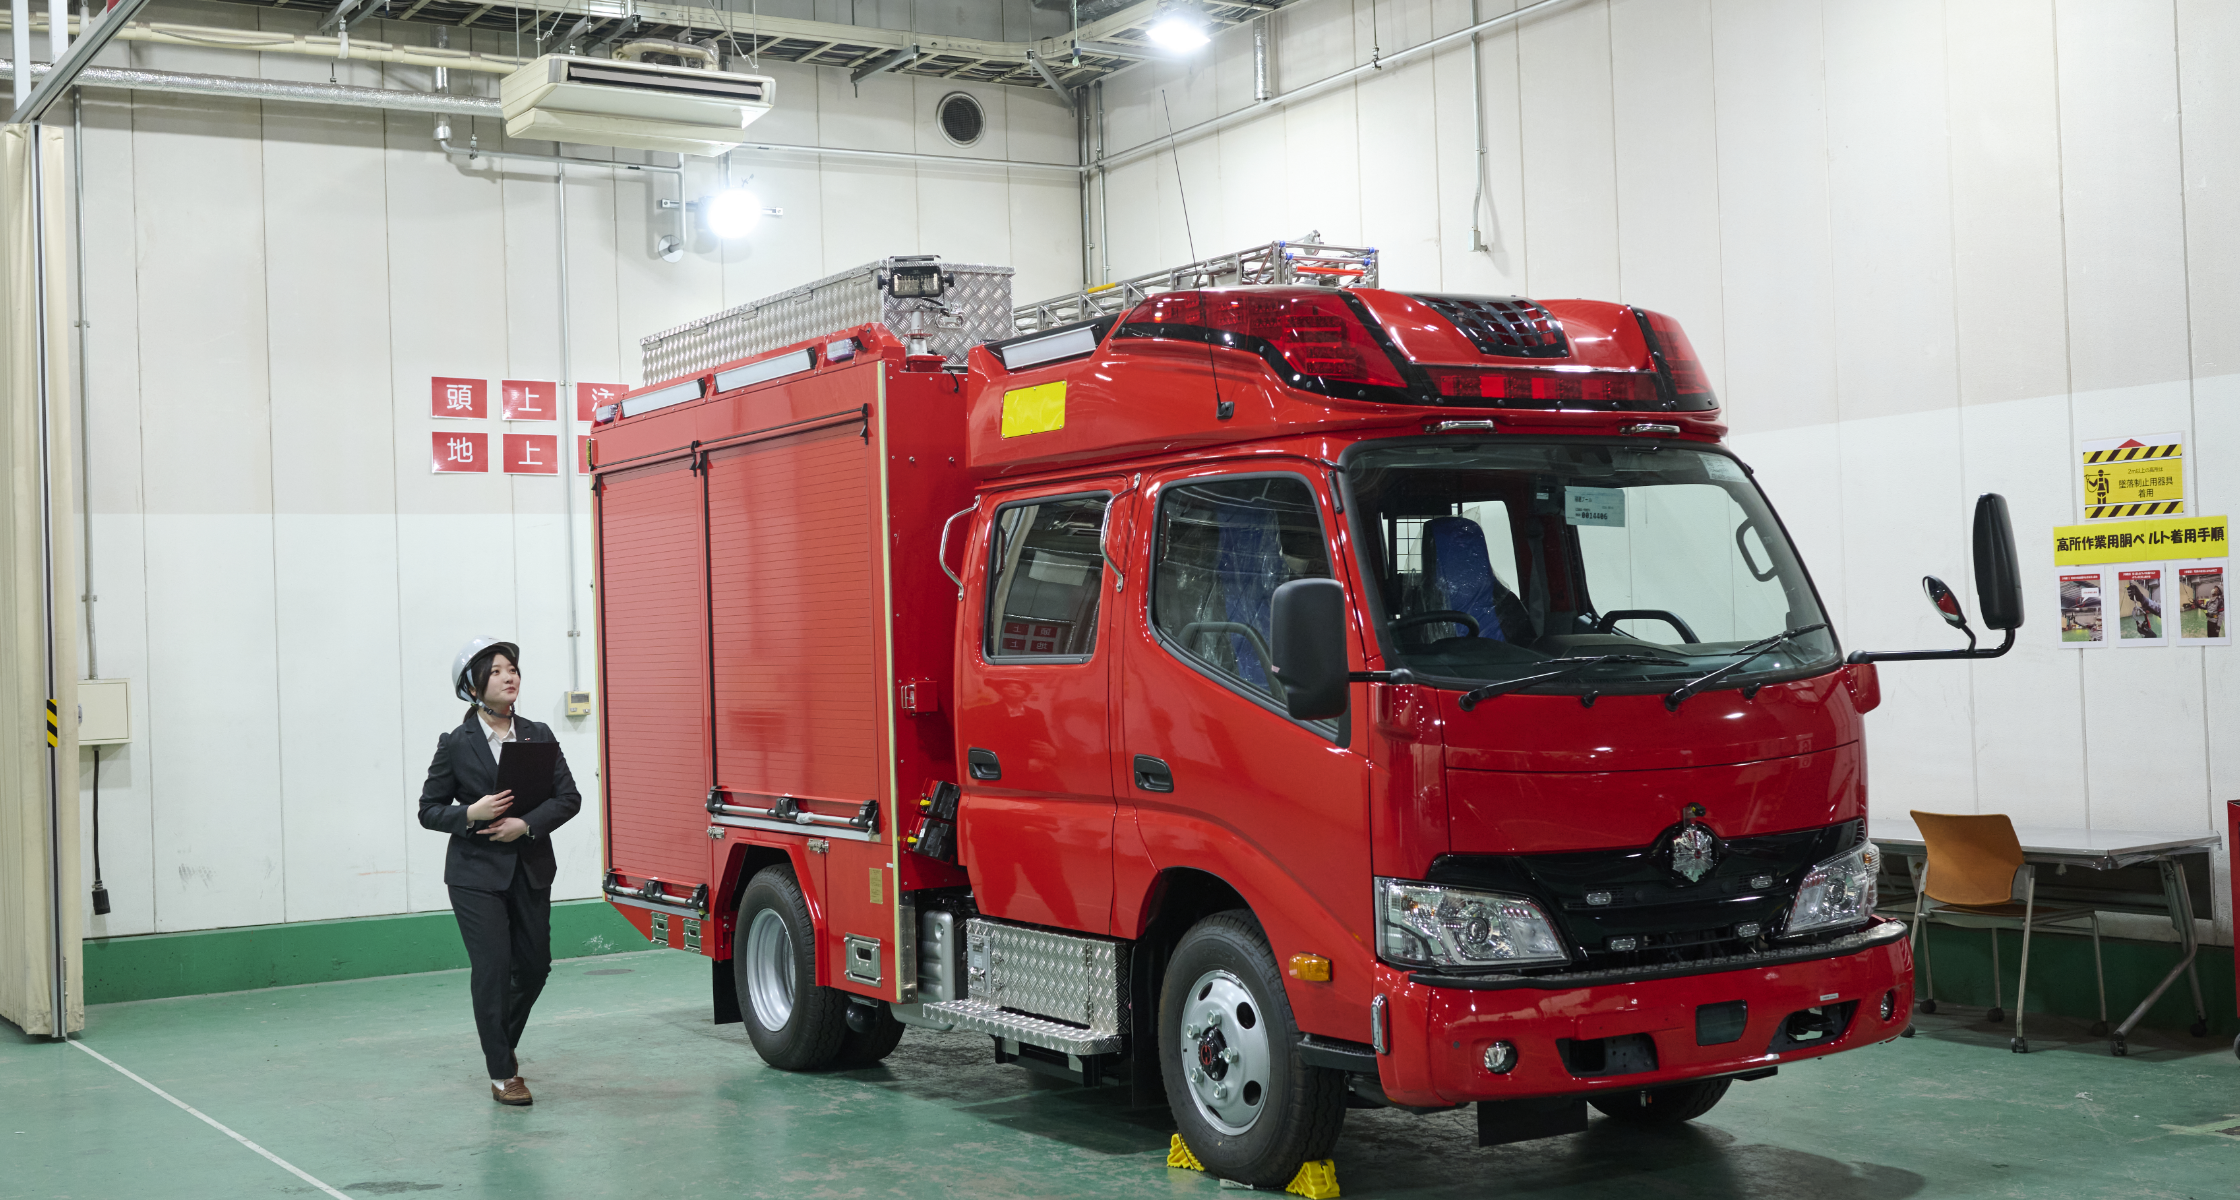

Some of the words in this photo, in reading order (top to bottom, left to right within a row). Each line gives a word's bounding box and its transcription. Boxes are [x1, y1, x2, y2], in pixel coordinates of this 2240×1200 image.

[2118, 476, 2173, 489] 墜落制止用器具
[2138, 488, 2154, 498] 着用
[2056, 526, 2225, 552] 高所作業用胴ベルト着用手順
